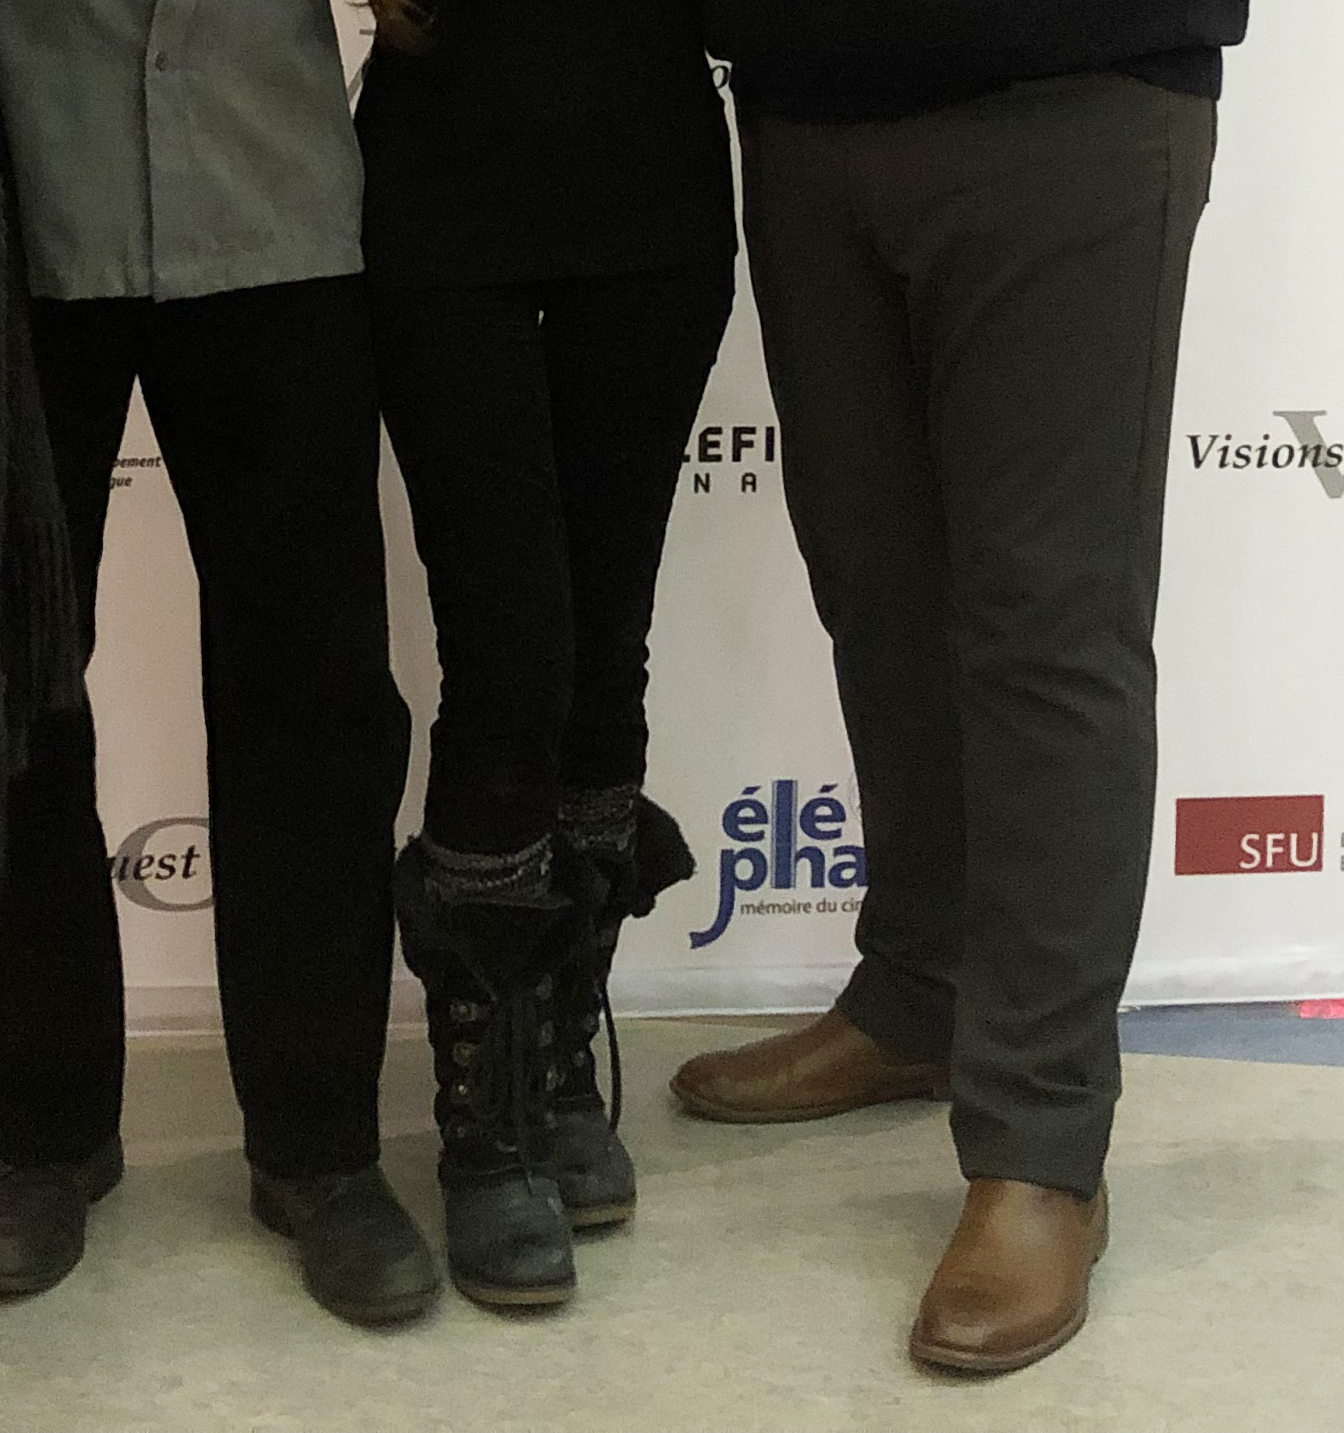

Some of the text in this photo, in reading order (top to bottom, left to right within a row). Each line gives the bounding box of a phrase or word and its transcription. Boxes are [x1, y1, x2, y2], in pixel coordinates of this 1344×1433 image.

[1186, 434, 1344, 469] Visions
[105, 843, 201, 882] uest
[1239, 832, 1319, 869] SFU
[741, 899, 812, 915] mémoire
[816, 898, 837, 913] du
